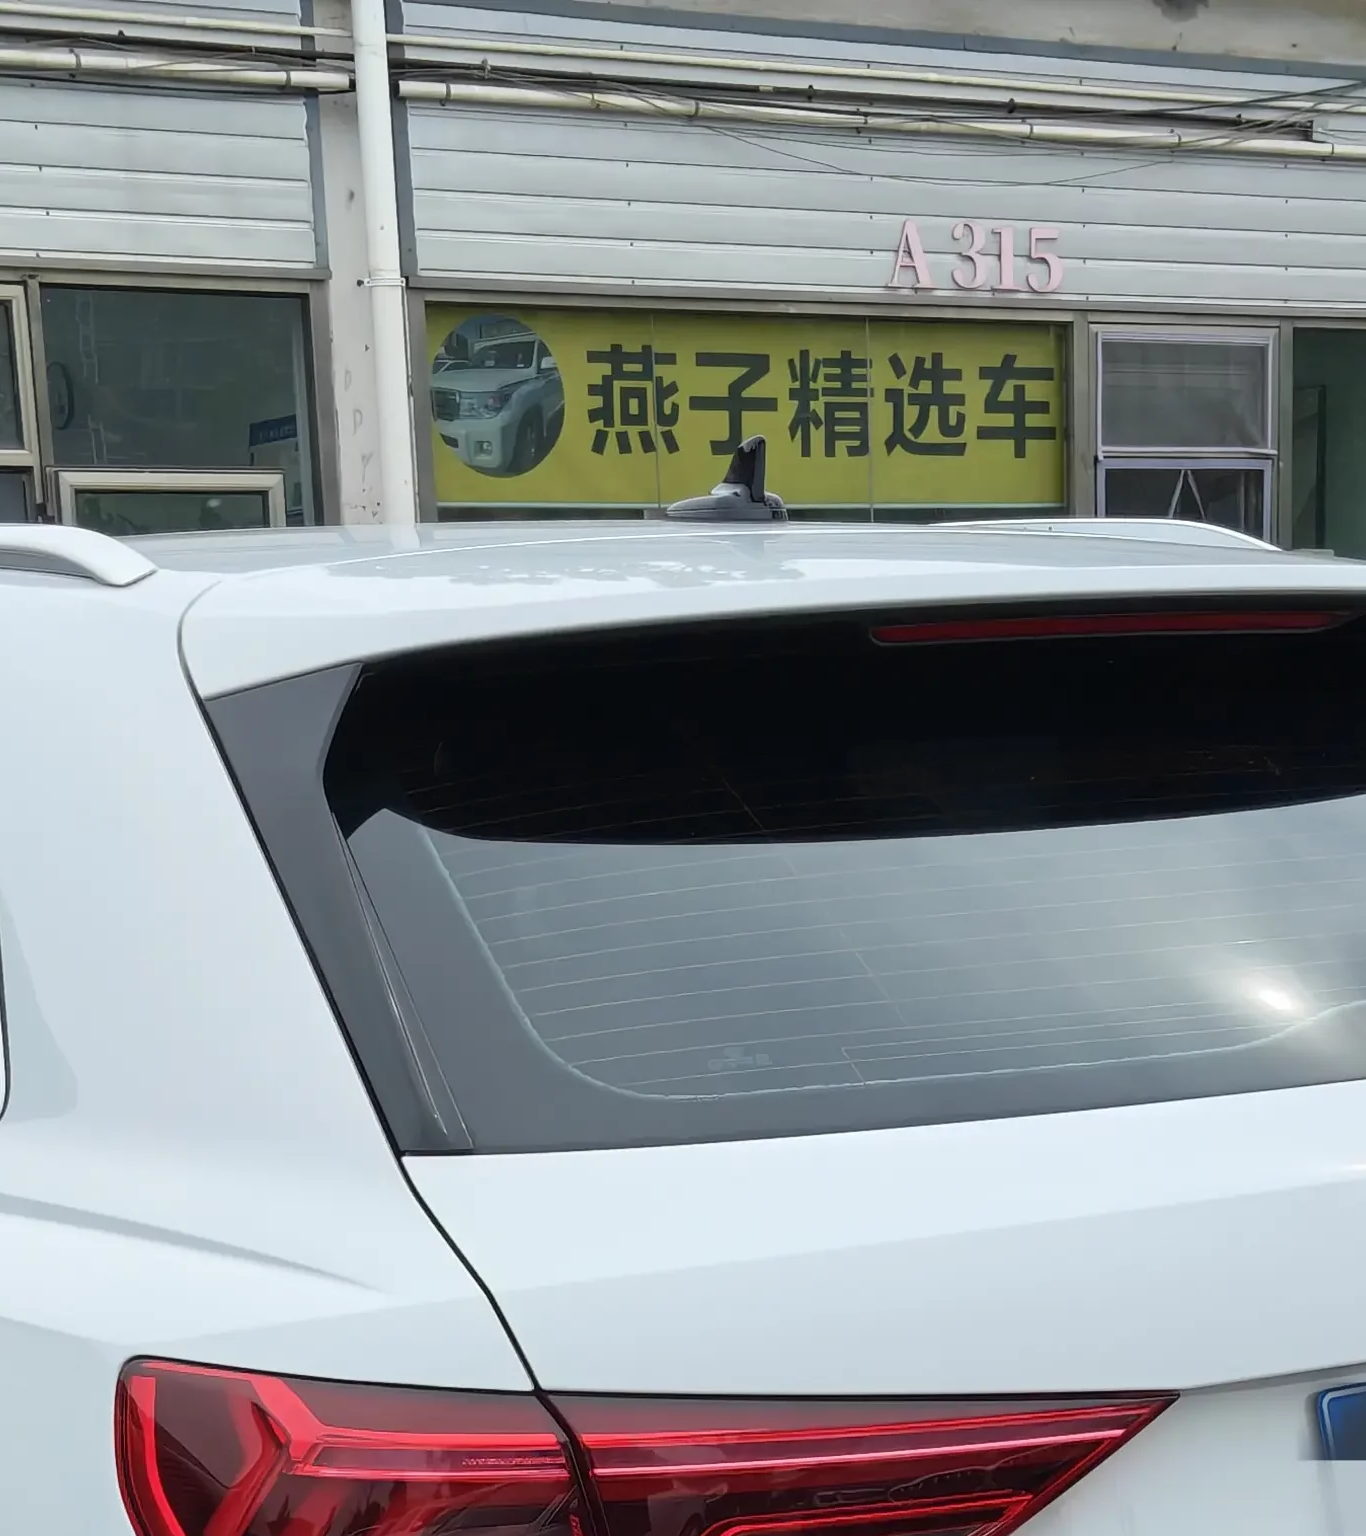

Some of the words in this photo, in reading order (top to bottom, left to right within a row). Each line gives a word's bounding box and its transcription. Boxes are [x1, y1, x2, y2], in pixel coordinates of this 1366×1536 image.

[886, 218, 1065, 294] A315
[585, 343, 1057, 459] 燕子精选车
